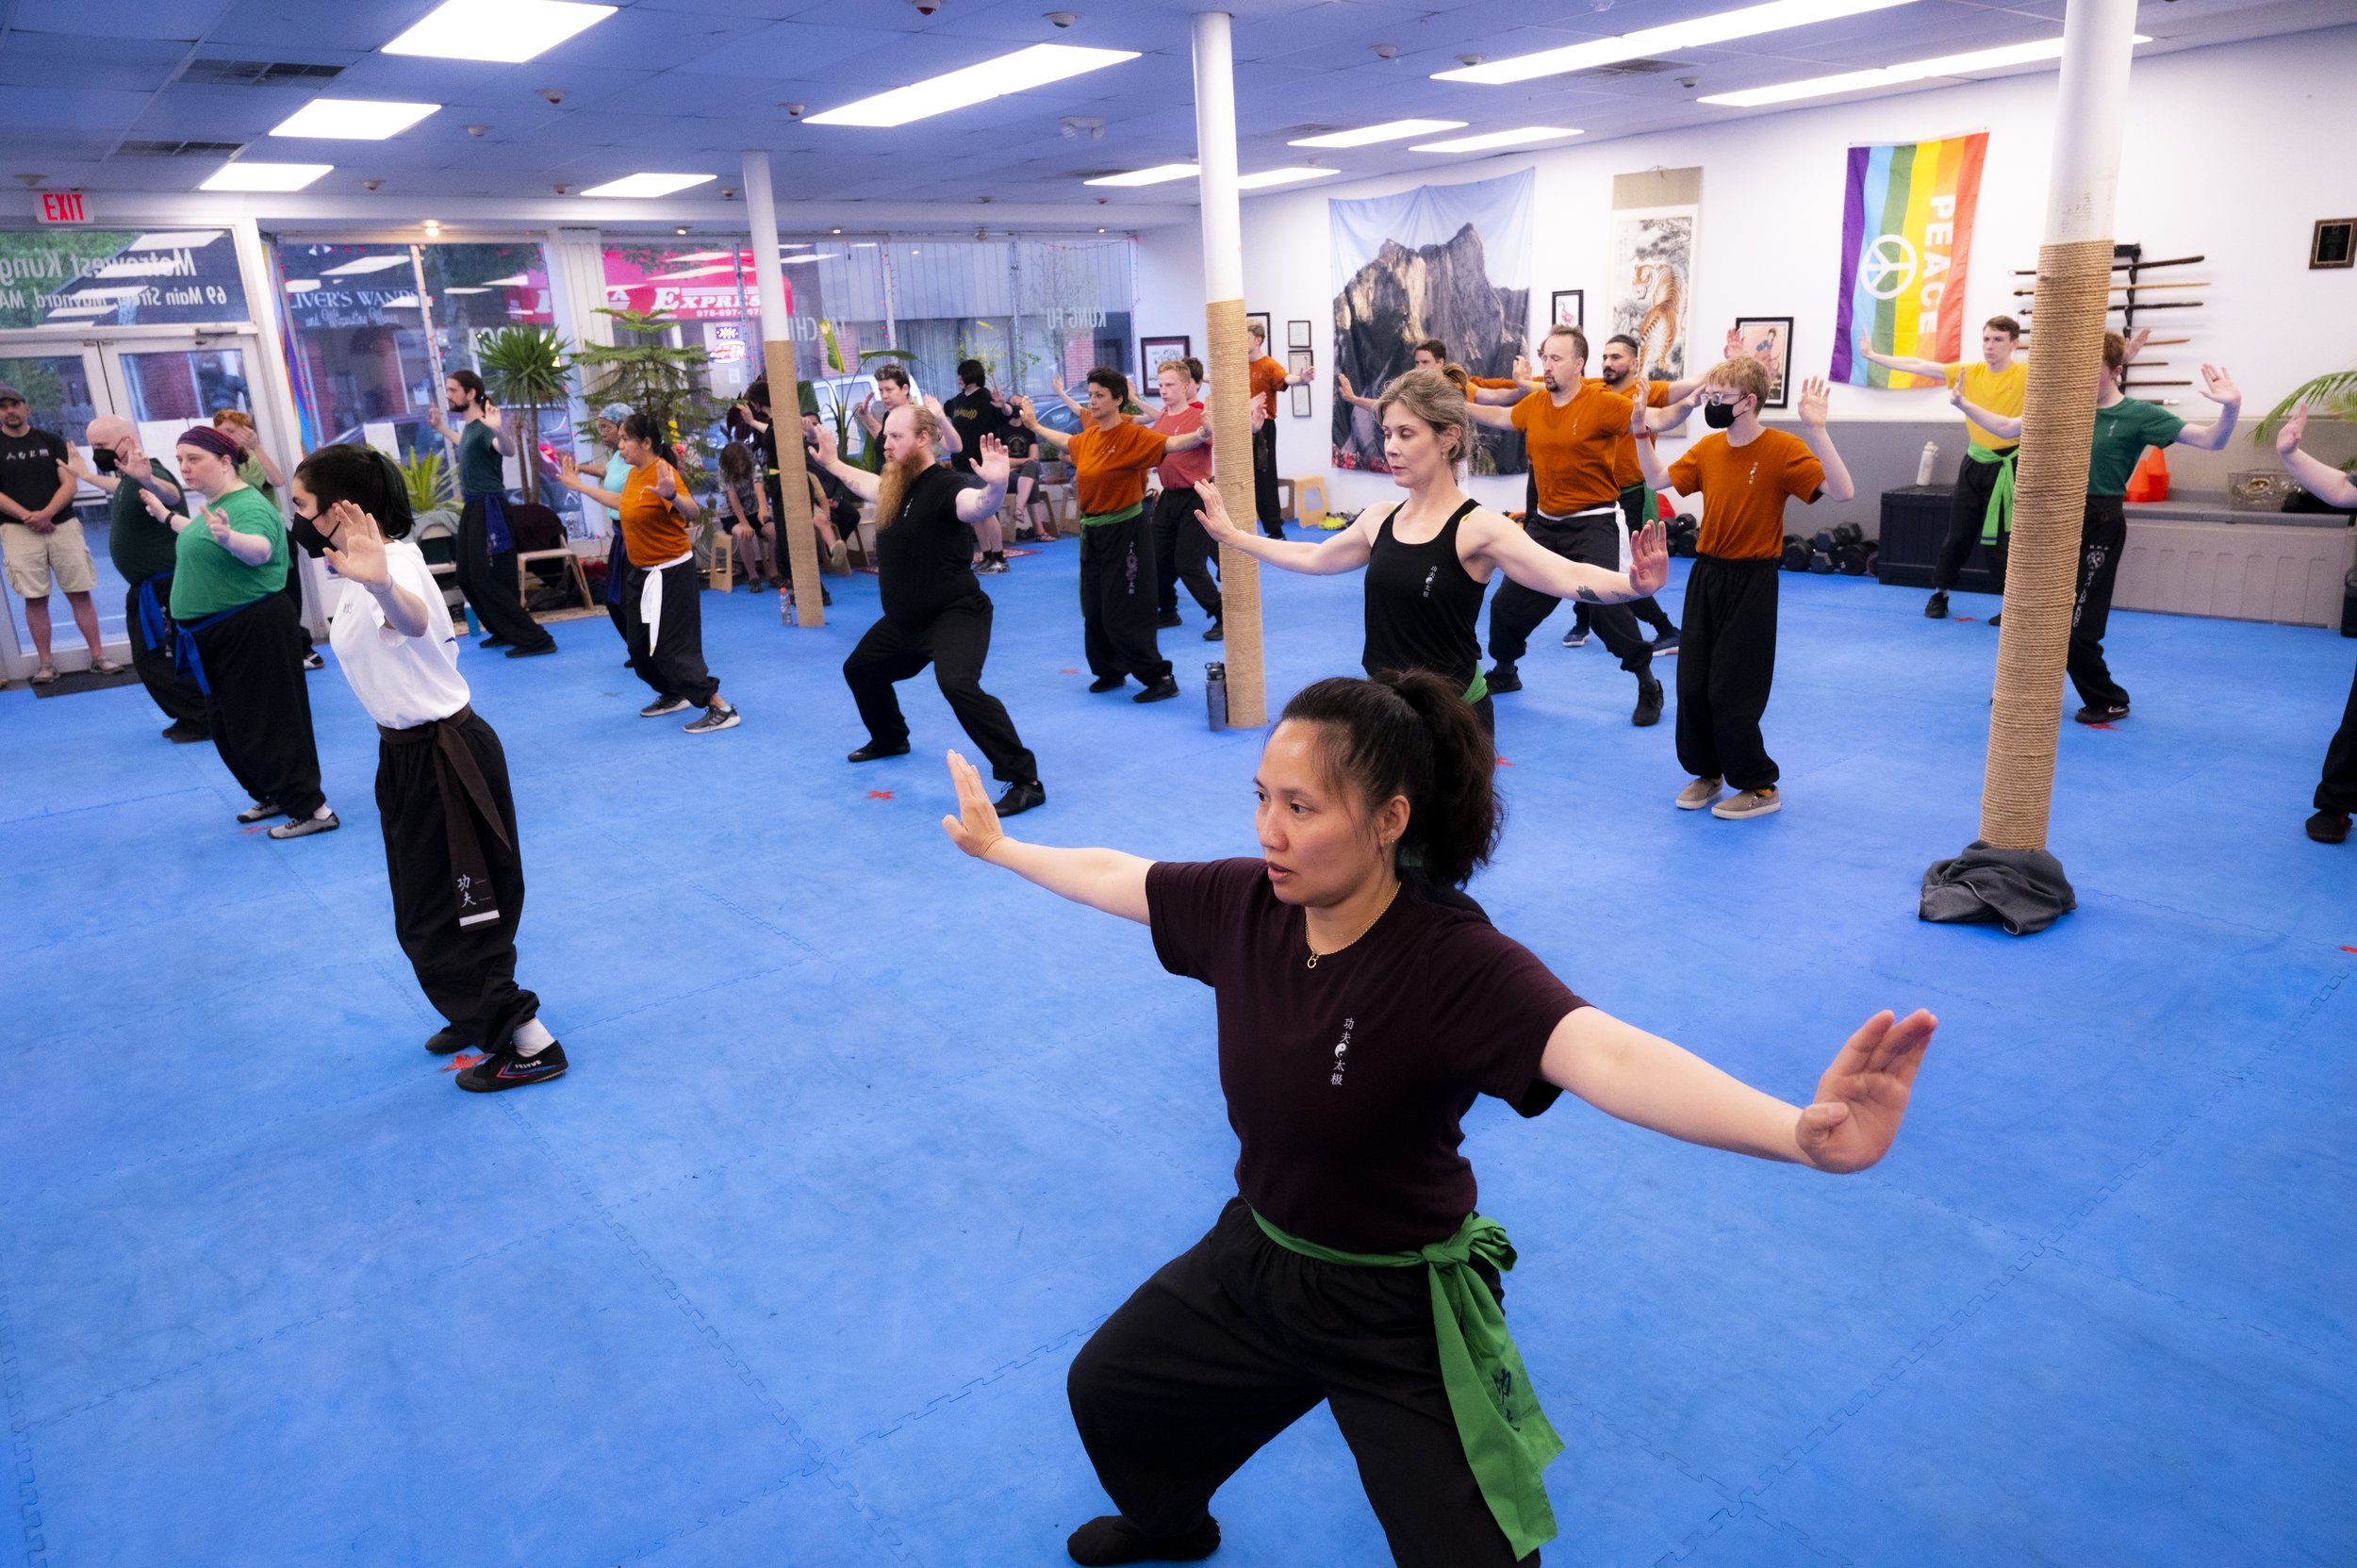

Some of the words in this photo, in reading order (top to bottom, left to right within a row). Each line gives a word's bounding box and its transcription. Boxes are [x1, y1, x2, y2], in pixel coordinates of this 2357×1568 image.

[43, 193, 85, 221] EXIT
[1919, 194, 1956, 335] PEACE
[651, 287, 761, 309] EXPRES
